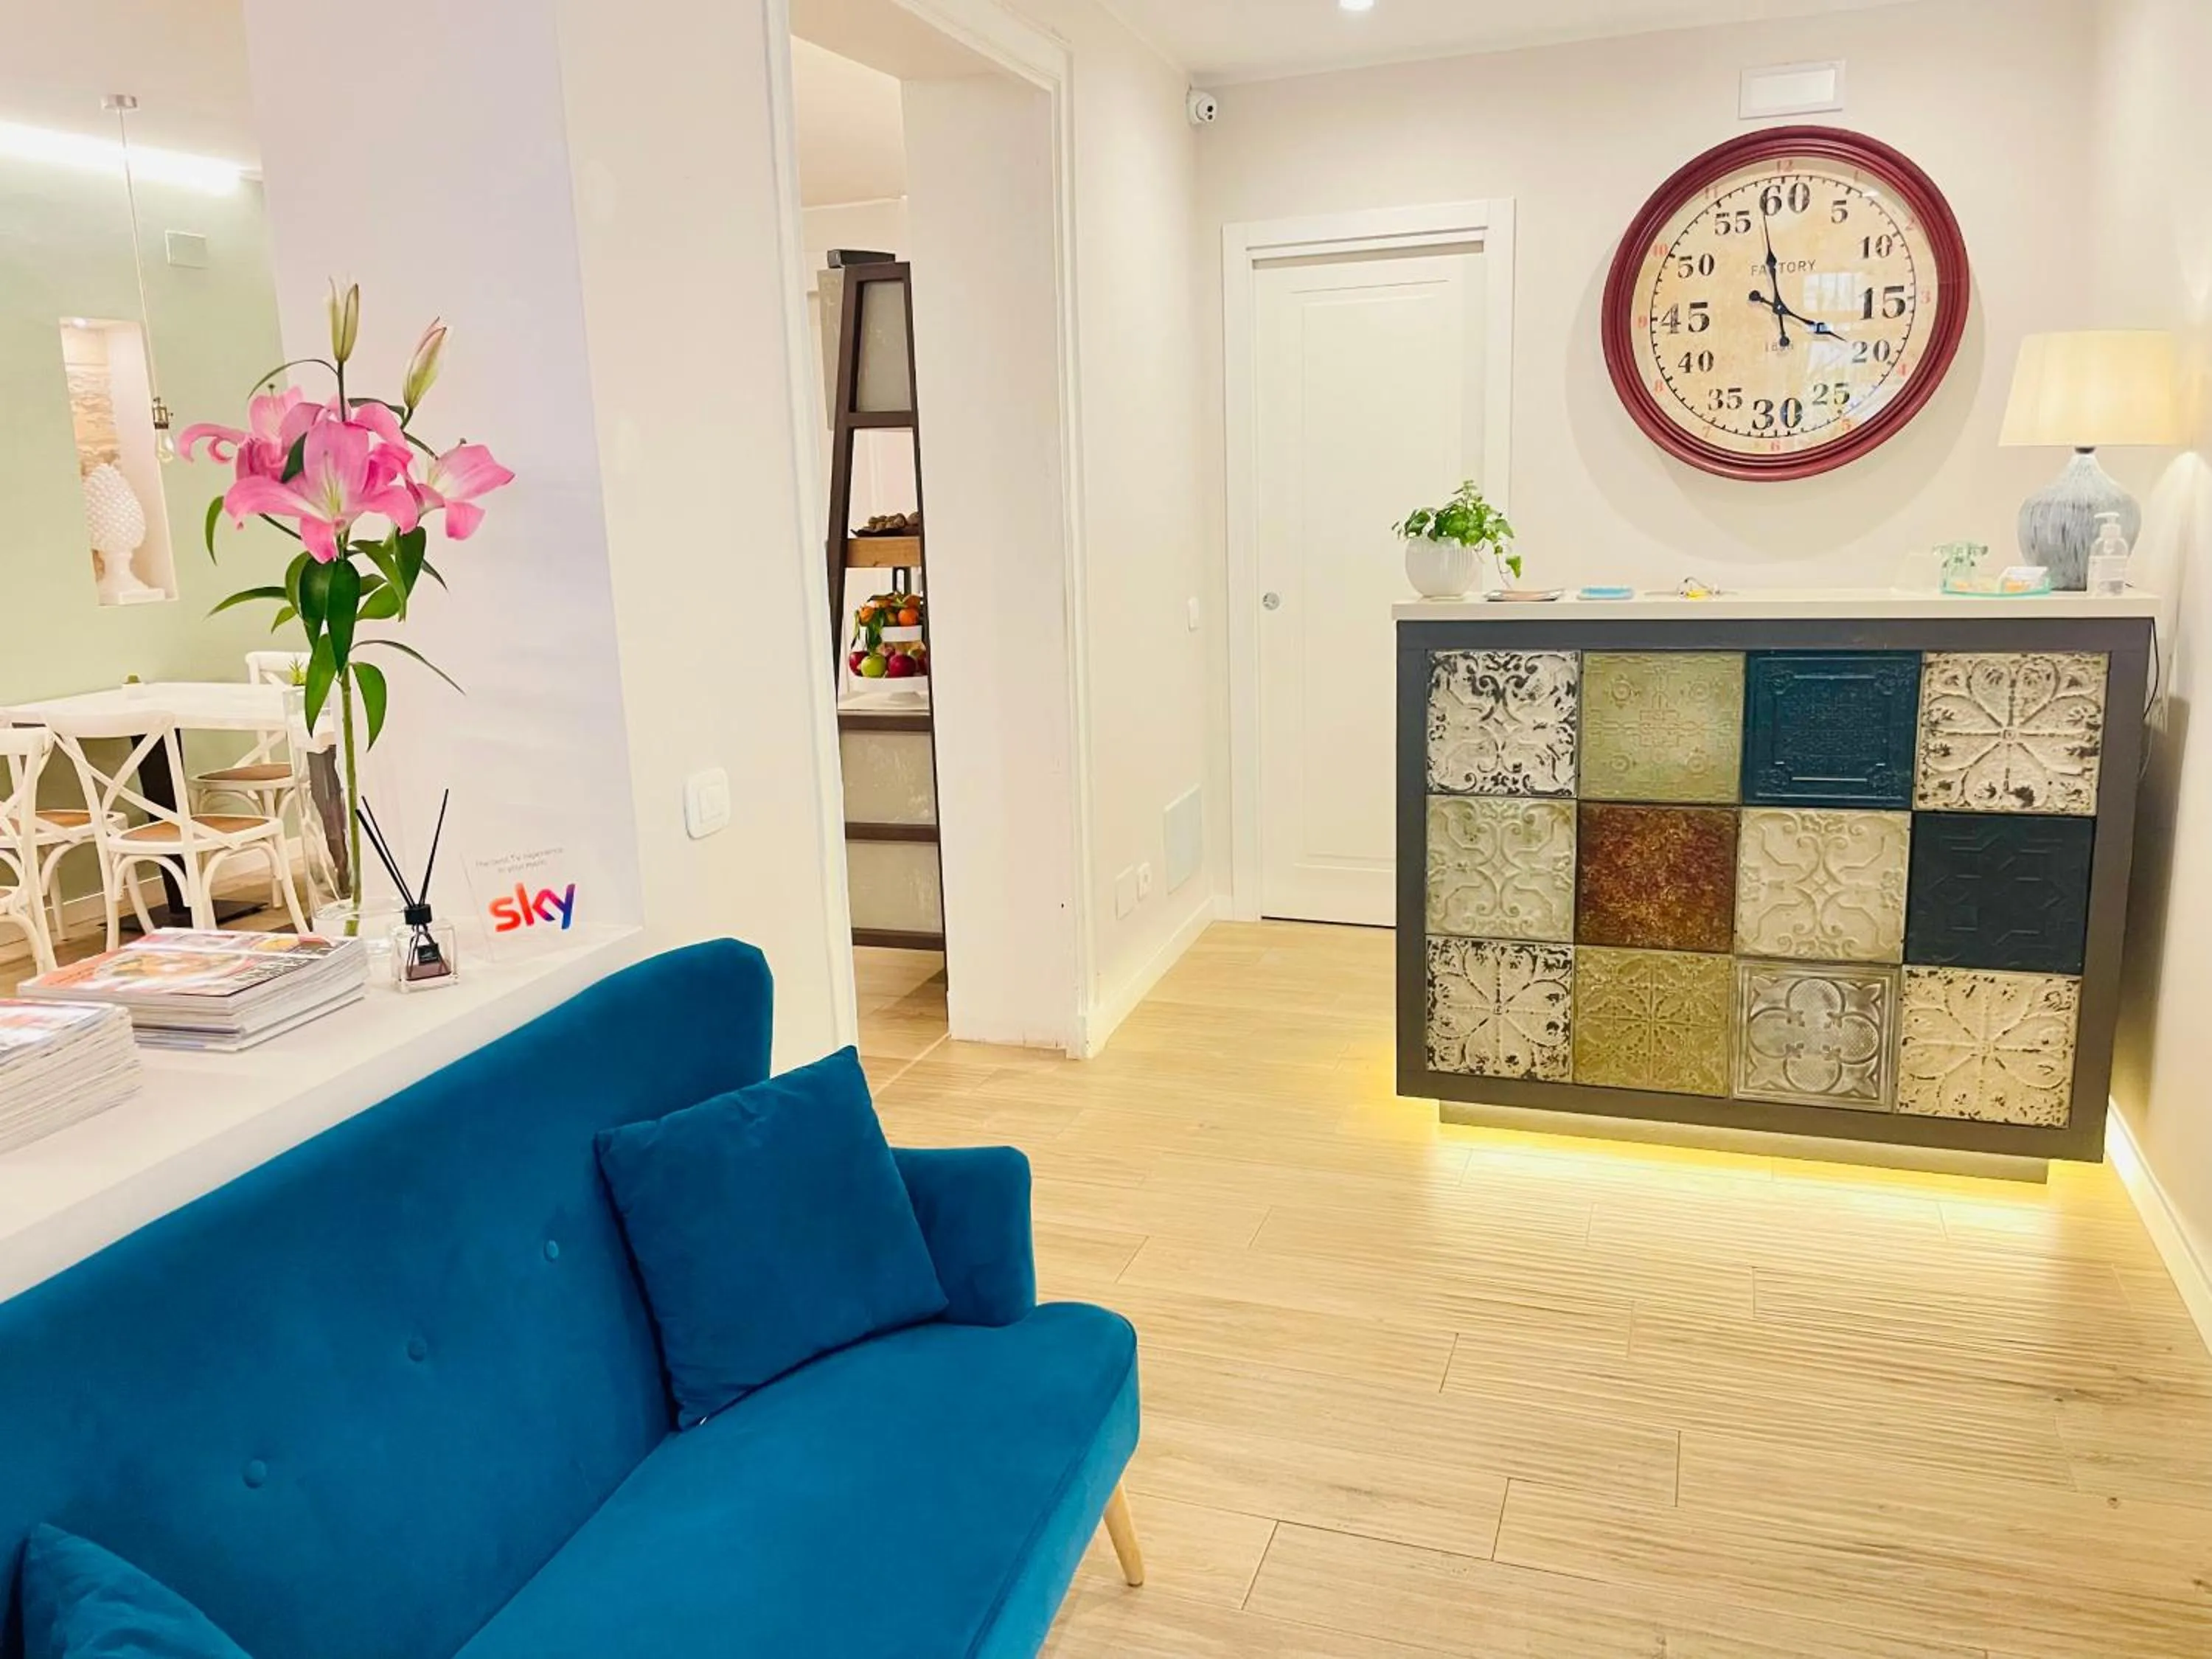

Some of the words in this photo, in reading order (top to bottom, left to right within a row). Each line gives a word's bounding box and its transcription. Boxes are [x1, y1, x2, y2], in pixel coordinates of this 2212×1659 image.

[1776, 160, 1792, 172] 12
[1760, 183, 1810, 216] 60
[1714, 211, 1751, 235] 55
[1831, 200, 1848, 224] 5
[1860, 234, 1893, 259] 10
[1677, 254, 1714, 278] 50
[1751, 260, 1816, 276] FATORY
[1859, 285, 1906, 320] 15
[1921, 290, 1930, 304] 3
[1660, 302, 1710, 334] 45
[1677, 349, 1714, 373] 40
[1851, 339, 1891, 364] 20
[1708, 388, 1743, 411] 35
[1812, 383, 1850, 406] 25
[1751, 397, 1804, 430] 30
[488, 883, 576, 932] sky
